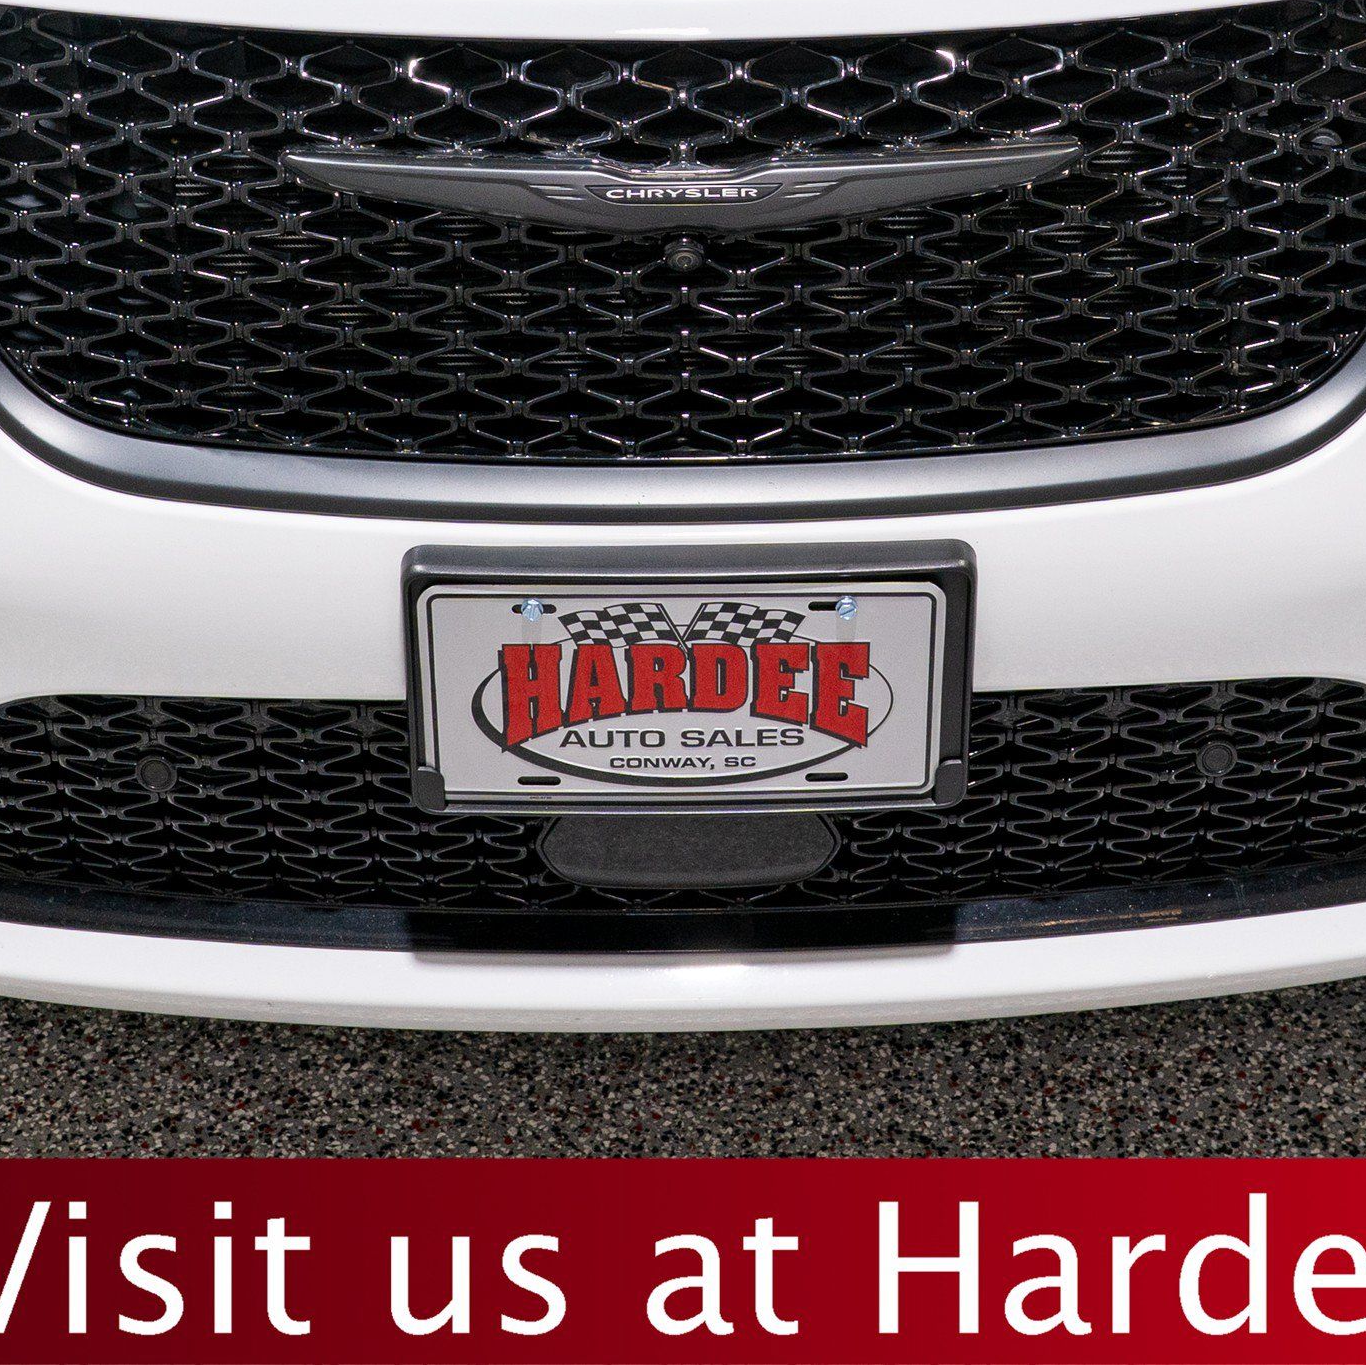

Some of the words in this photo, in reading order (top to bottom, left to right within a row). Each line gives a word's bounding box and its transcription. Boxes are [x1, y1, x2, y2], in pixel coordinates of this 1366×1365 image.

[605, 187, 758, 199] CHRYSLER
[498, 641, 871, 751] HARDEE
[559, 729, 666, 748] AUTO
[680, 728, 805, 747] SALES
[609, 756, 715, 770] CONWAY,
[724, 756, 757, 768] SC
